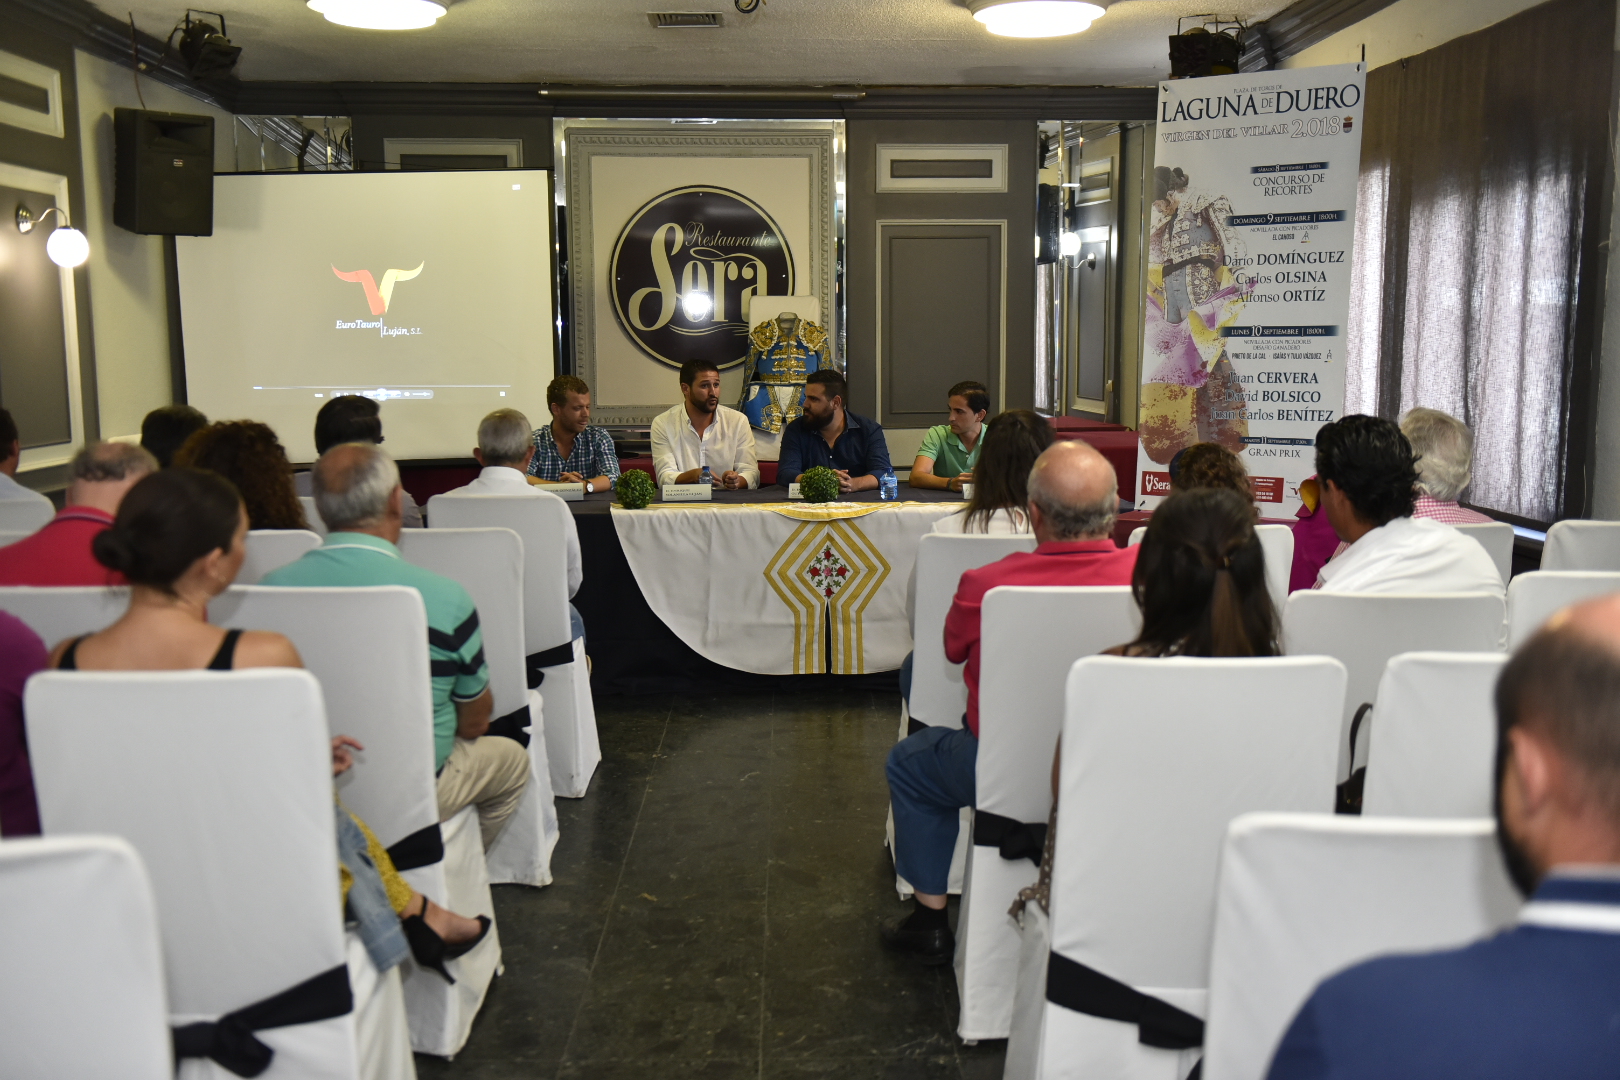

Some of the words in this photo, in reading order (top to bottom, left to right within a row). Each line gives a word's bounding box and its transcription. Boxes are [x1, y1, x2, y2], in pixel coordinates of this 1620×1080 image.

[1161, 93, 1259, 123] LAGUNA
[1261, 97, 1274, 110] DE
[1275, 84, 1361, 114] DUERO
[1161, 129, 1210, 143] VIRGEN
[1212, 128, 1238, 140] DEL
[1240, 124, 1289, 137] VILLAR
[1291, 116, 1341, 138] 2.018
[1275, 164, 1280, 172] 8
[1253, 174, 1310, 187] CONCURSO
[1312, 173, 1325, 184] DE
[1264, 184, 1313, 197] RECORTES
[1267, 213, 1274, 224] 9
[1274, 214, 1311, 222] SEPTIEMBRE
[685, 221, 772, 248] Restaurante
[1222, 254, 1254, 267] Darío
[1256, 250, 1345, 266] DOMÍNGUEZ
[628, 222, 768, 332] Sora
[1236, 272, 1272, 284] Carlos
[1275, 270, 1327, 284] OLSINA
[1236, 290, 1280, 302] Alfonso
[1283, 286, 1326, 302] ORTÍZ
[336, 320, 380, 329] EuroTauro
[1251, 325, 1262, 336] 10
[1228, 372, 1254, 386] Juan
[1258, 372, 1319, 384] CERVERA
[1224, 390, 1258, 402] David
[1262, 391, 1321, 403] BOLSICO
[1210, 408, 1236, 422] Juan
[1238, 408, 1274, 421] Carlos
[1277, 406, 1334, 422] BENÍTEZ
[1248, 448, 1277, 457] GRAN
[1279, 449, 1301, 458] PRIX
[1153, 478, 1171, 490] Sera
